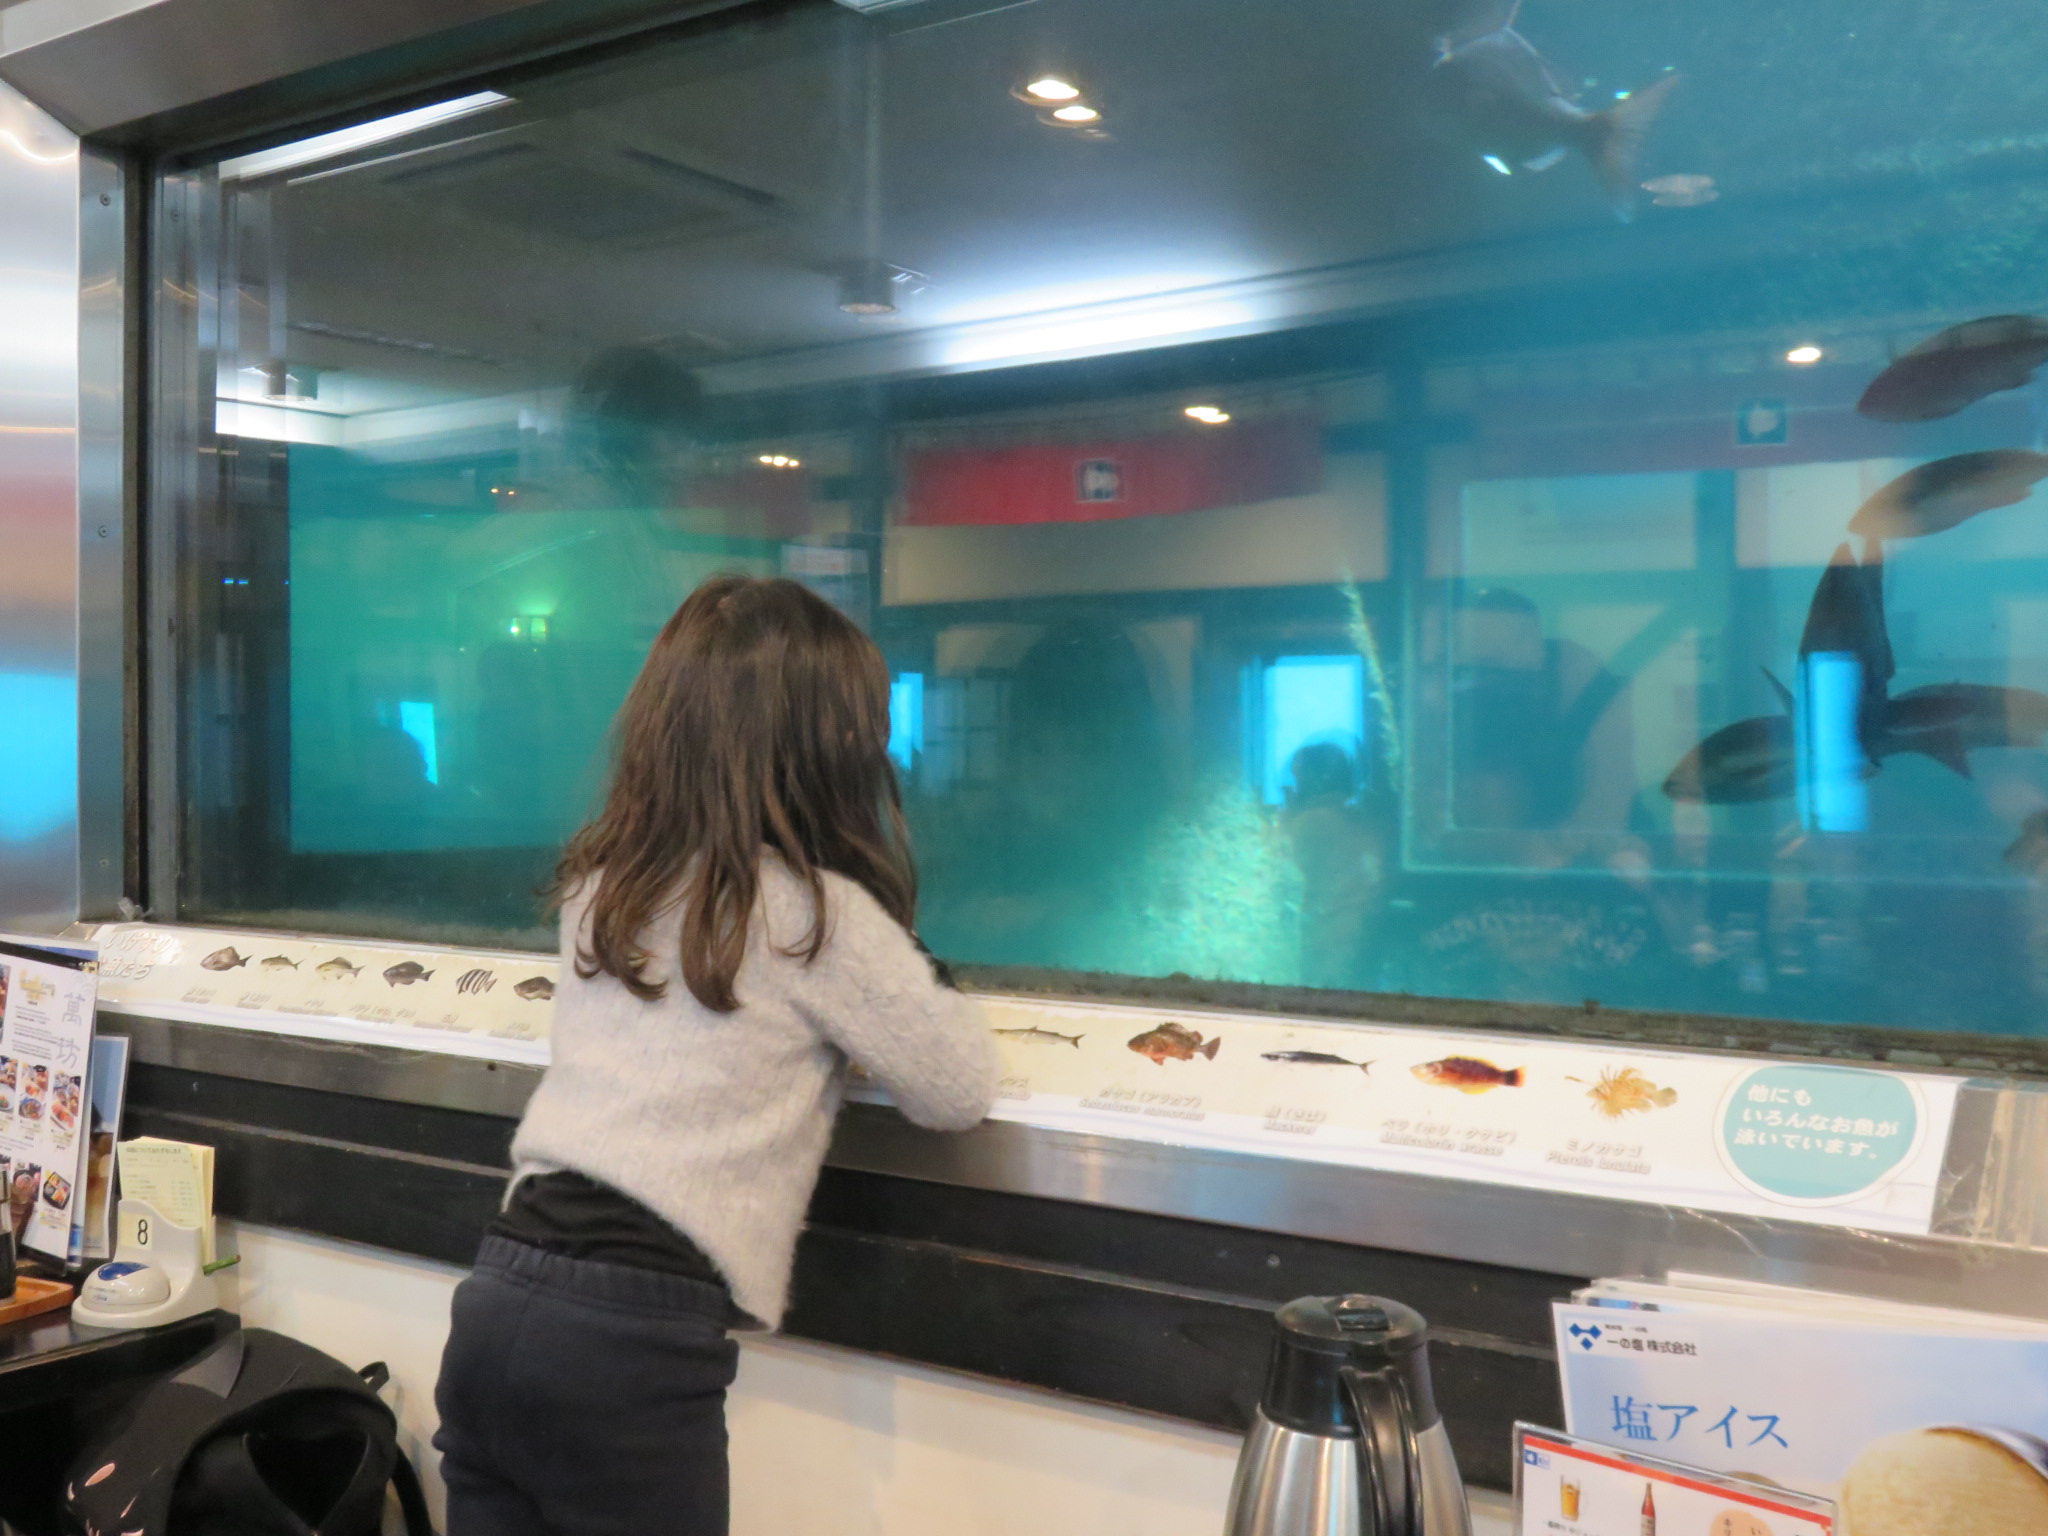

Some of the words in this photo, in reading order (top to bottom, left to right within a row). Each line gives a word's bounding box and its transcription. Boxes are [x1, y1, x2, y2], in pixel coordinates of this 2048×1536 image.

[100, 956, 155, 980] 魚たち
[1748, 1084, 1811, 1106] 他にも
[1742, 1108, 1899, 1138] いろんなお魚が
[1733, 1127, 1877, 1159] 泳いでいます。
[137, 1218, 148, 1246] 8
[1646, 1339, 1698, 1356] 株式会社
[1612, 1395, 1789, 1449] 塩アイス
